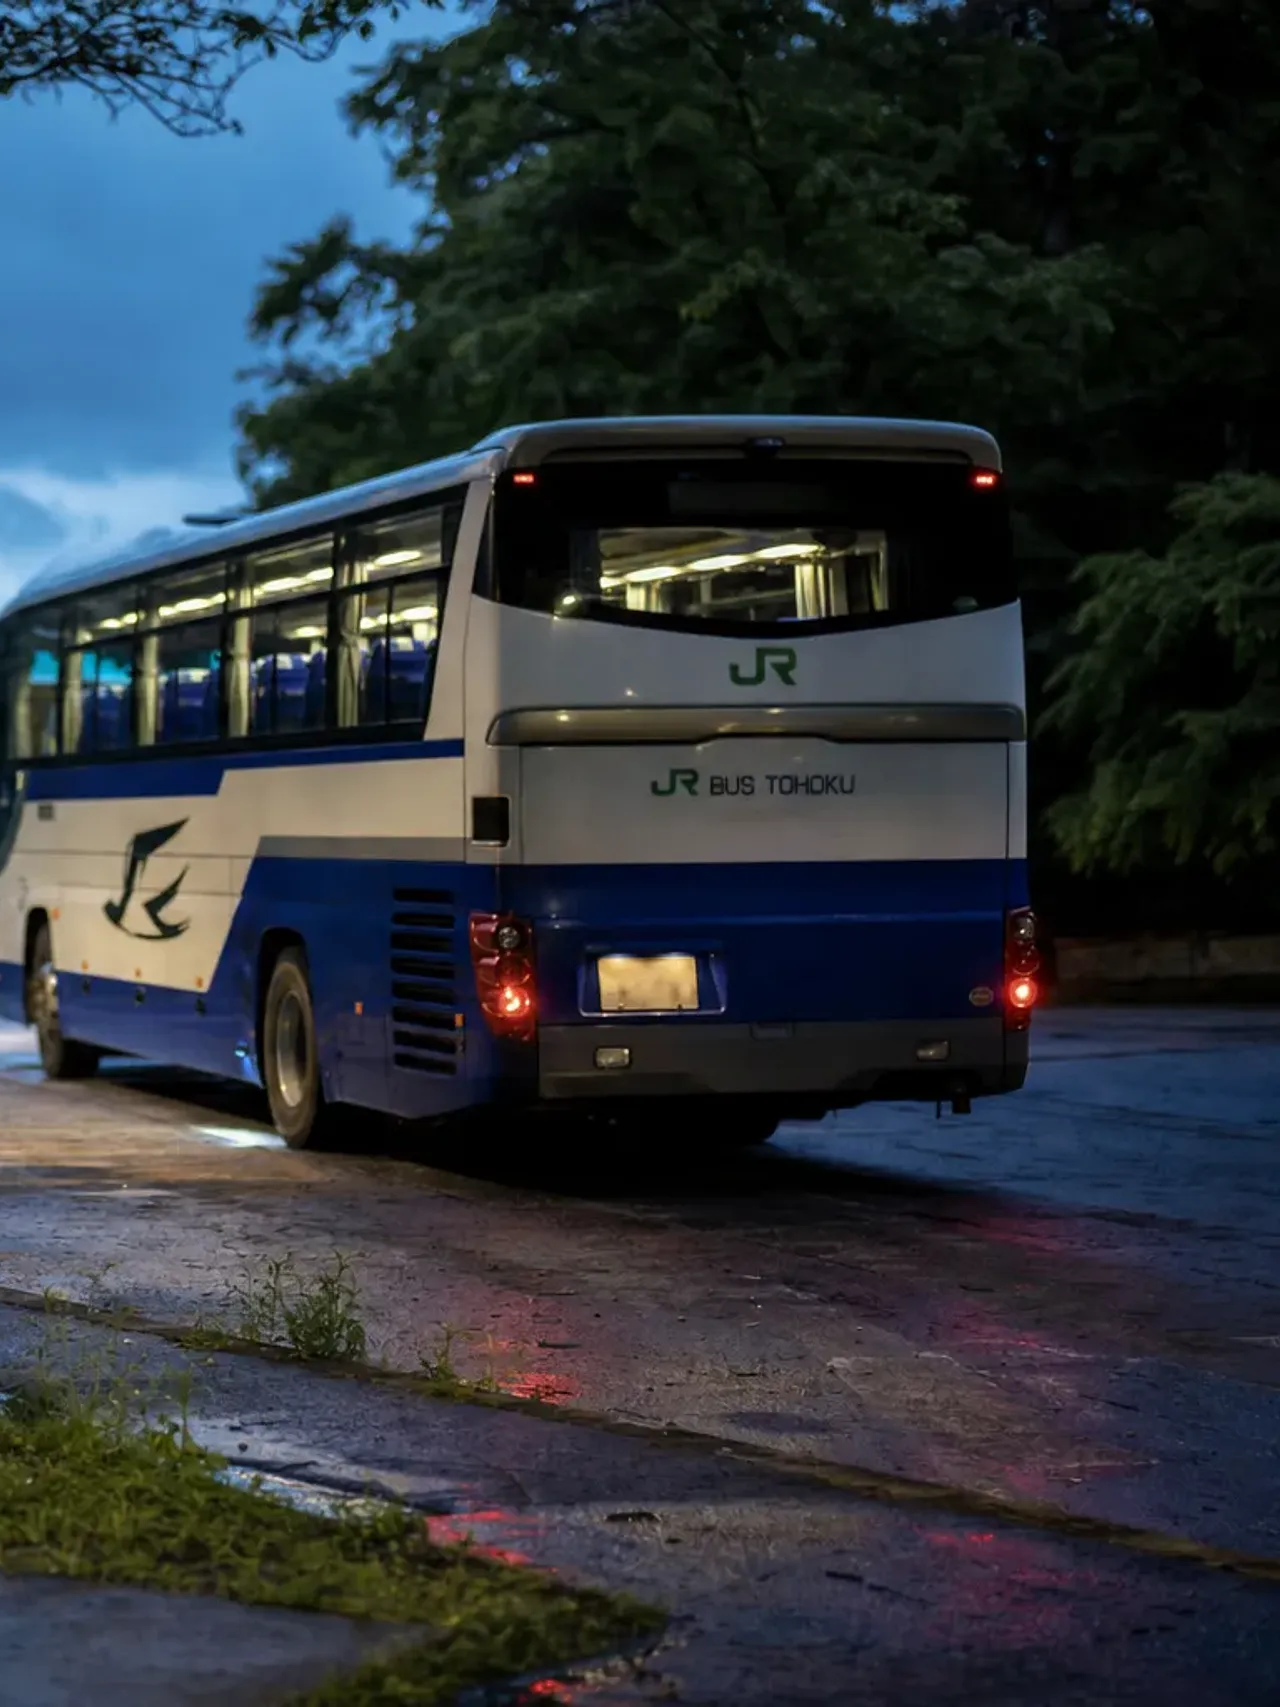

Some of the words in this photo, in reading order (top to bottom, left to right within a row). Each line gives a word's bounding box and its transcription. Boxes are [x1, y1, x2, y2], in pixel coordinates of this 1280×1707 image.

[729, 647, 797, 686] JR
[651, 768, 699, 796] JR
[710, 775, 755, 795] BUS
[766, 774, 856, 795] TOHOKU
